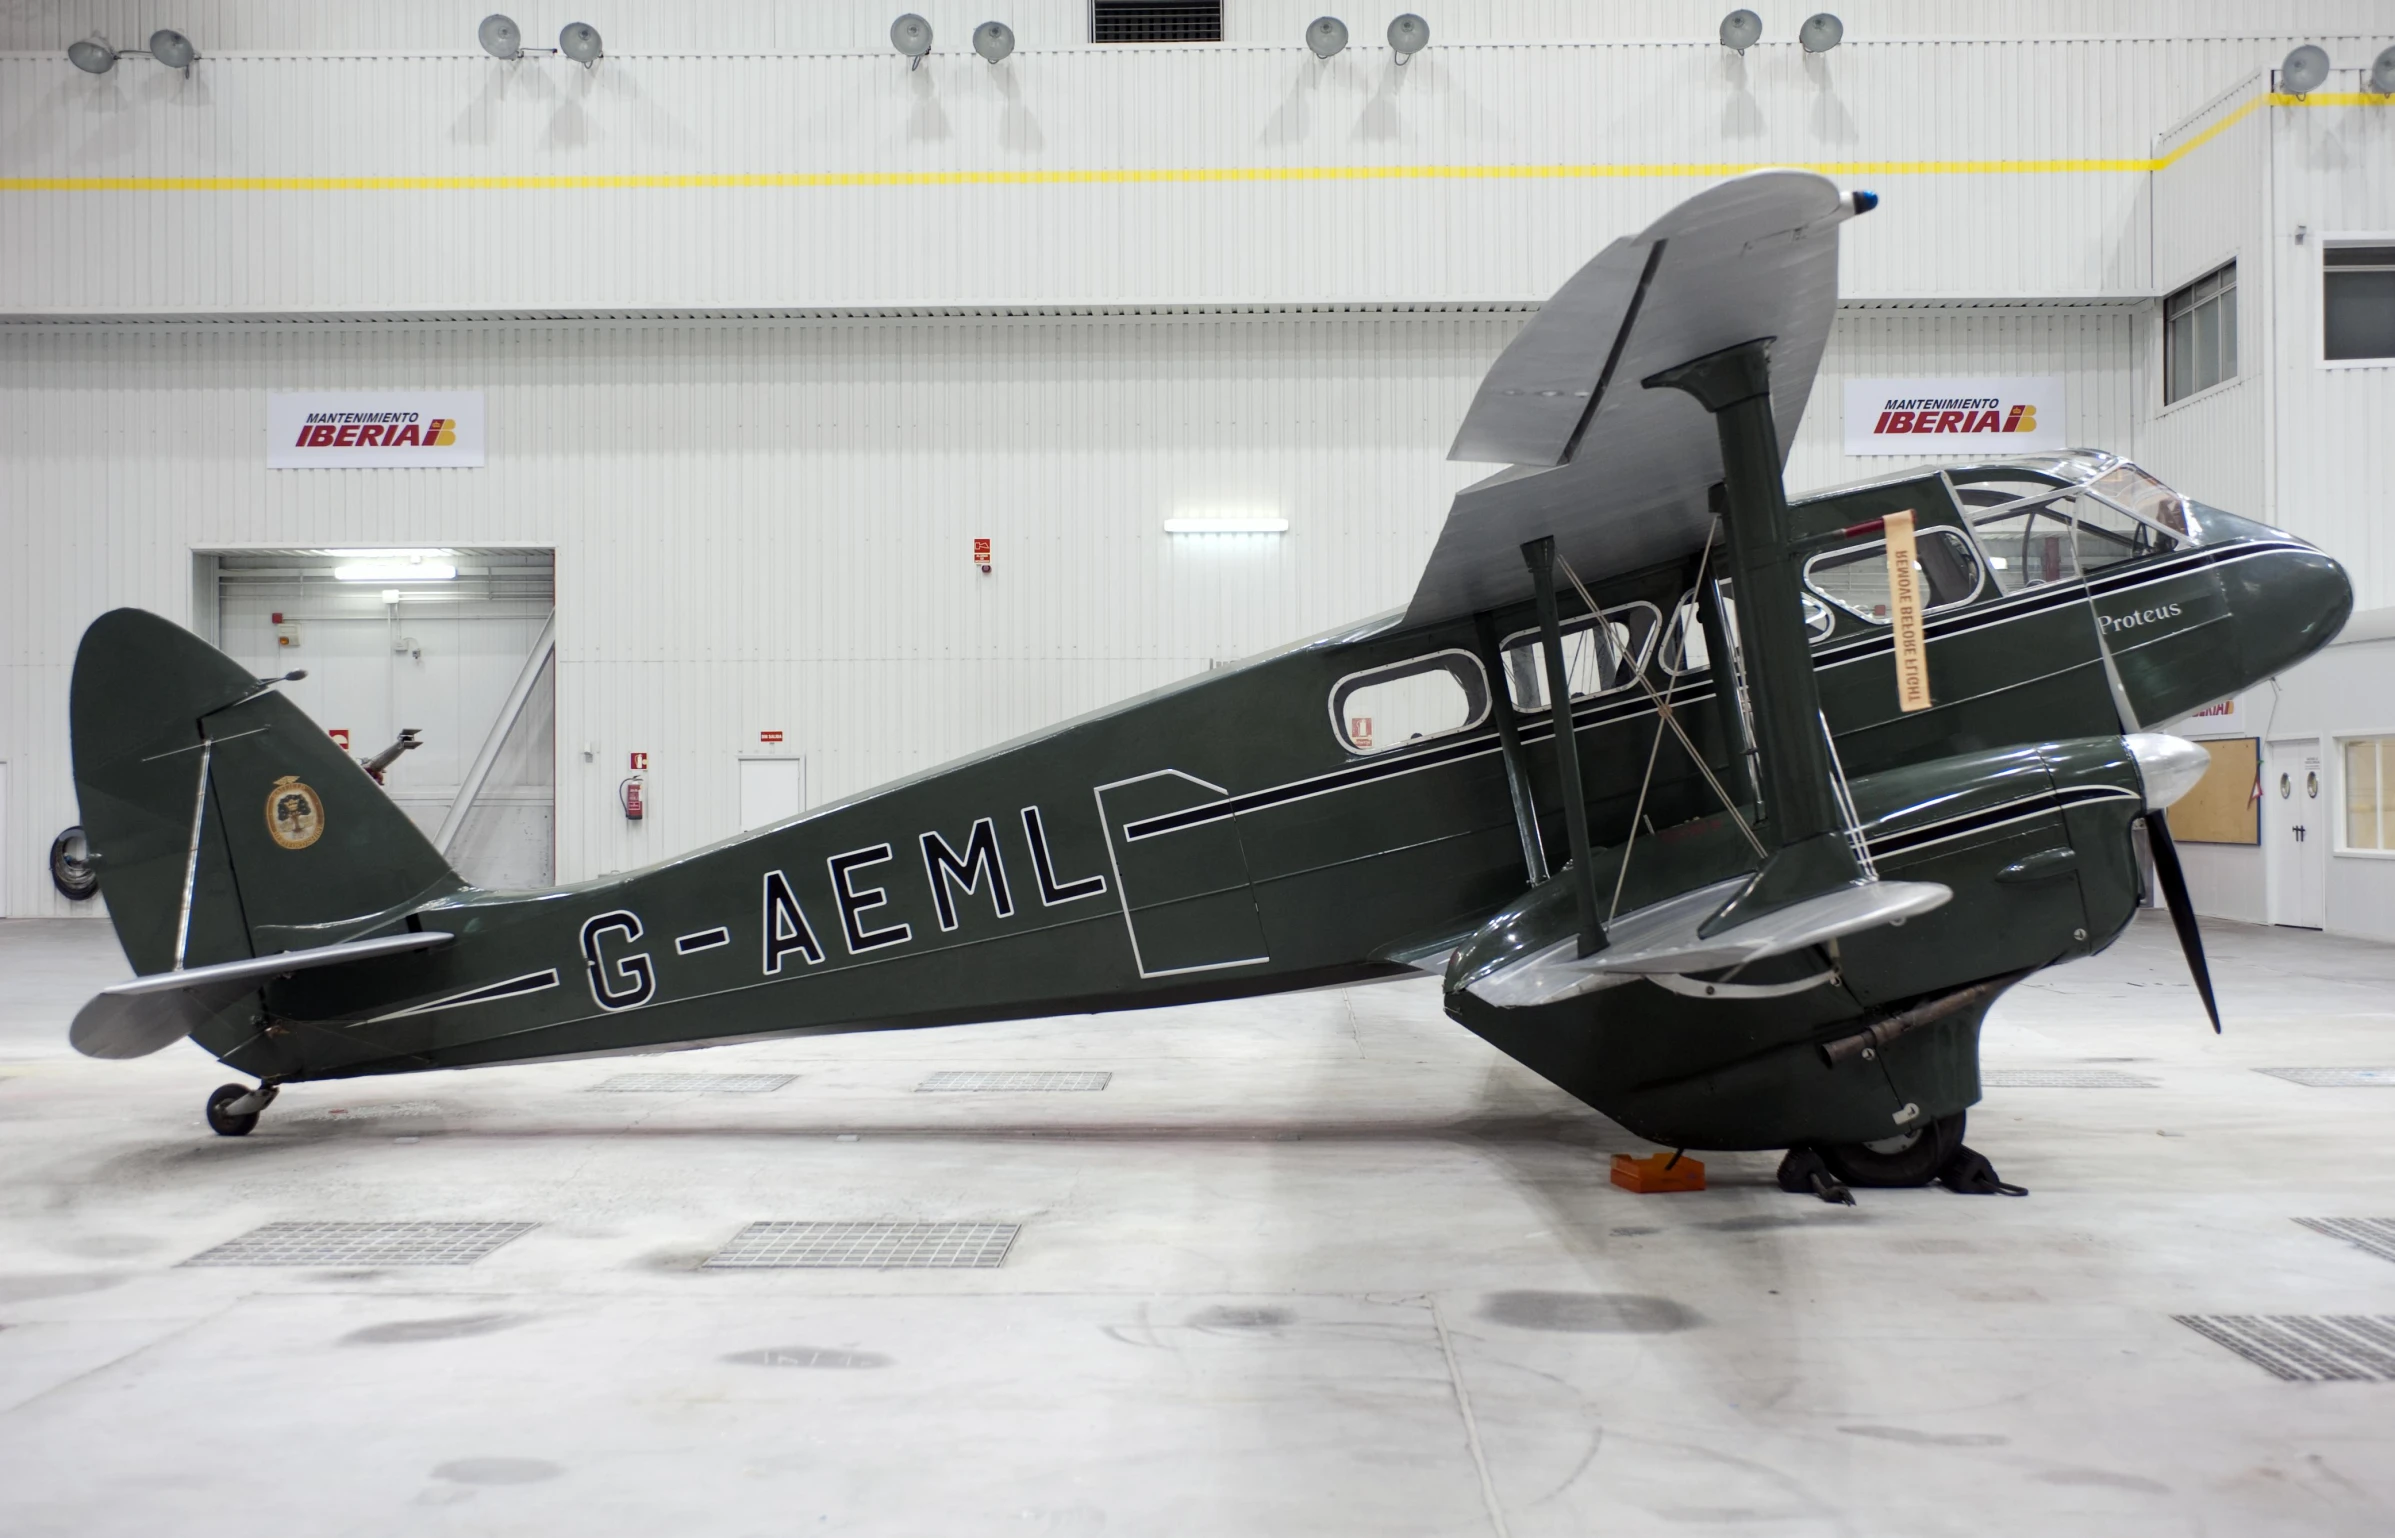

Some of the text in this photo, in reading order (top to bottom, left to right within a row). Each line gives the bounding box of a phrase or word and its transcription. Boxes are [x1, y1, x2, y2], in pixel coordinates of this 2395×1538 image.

[1884, 398, 1999, 410] MANTENIMIENTO
[306, 412, 419, 424] MANTENIMIENTO
[1873, 411, 2000, 433] IBERIA
[295, 424, 420, 447] IBERIA
[2098, 603, 2182, 635] Proteus
[580, 805, 1107, 1012] G-AEML
